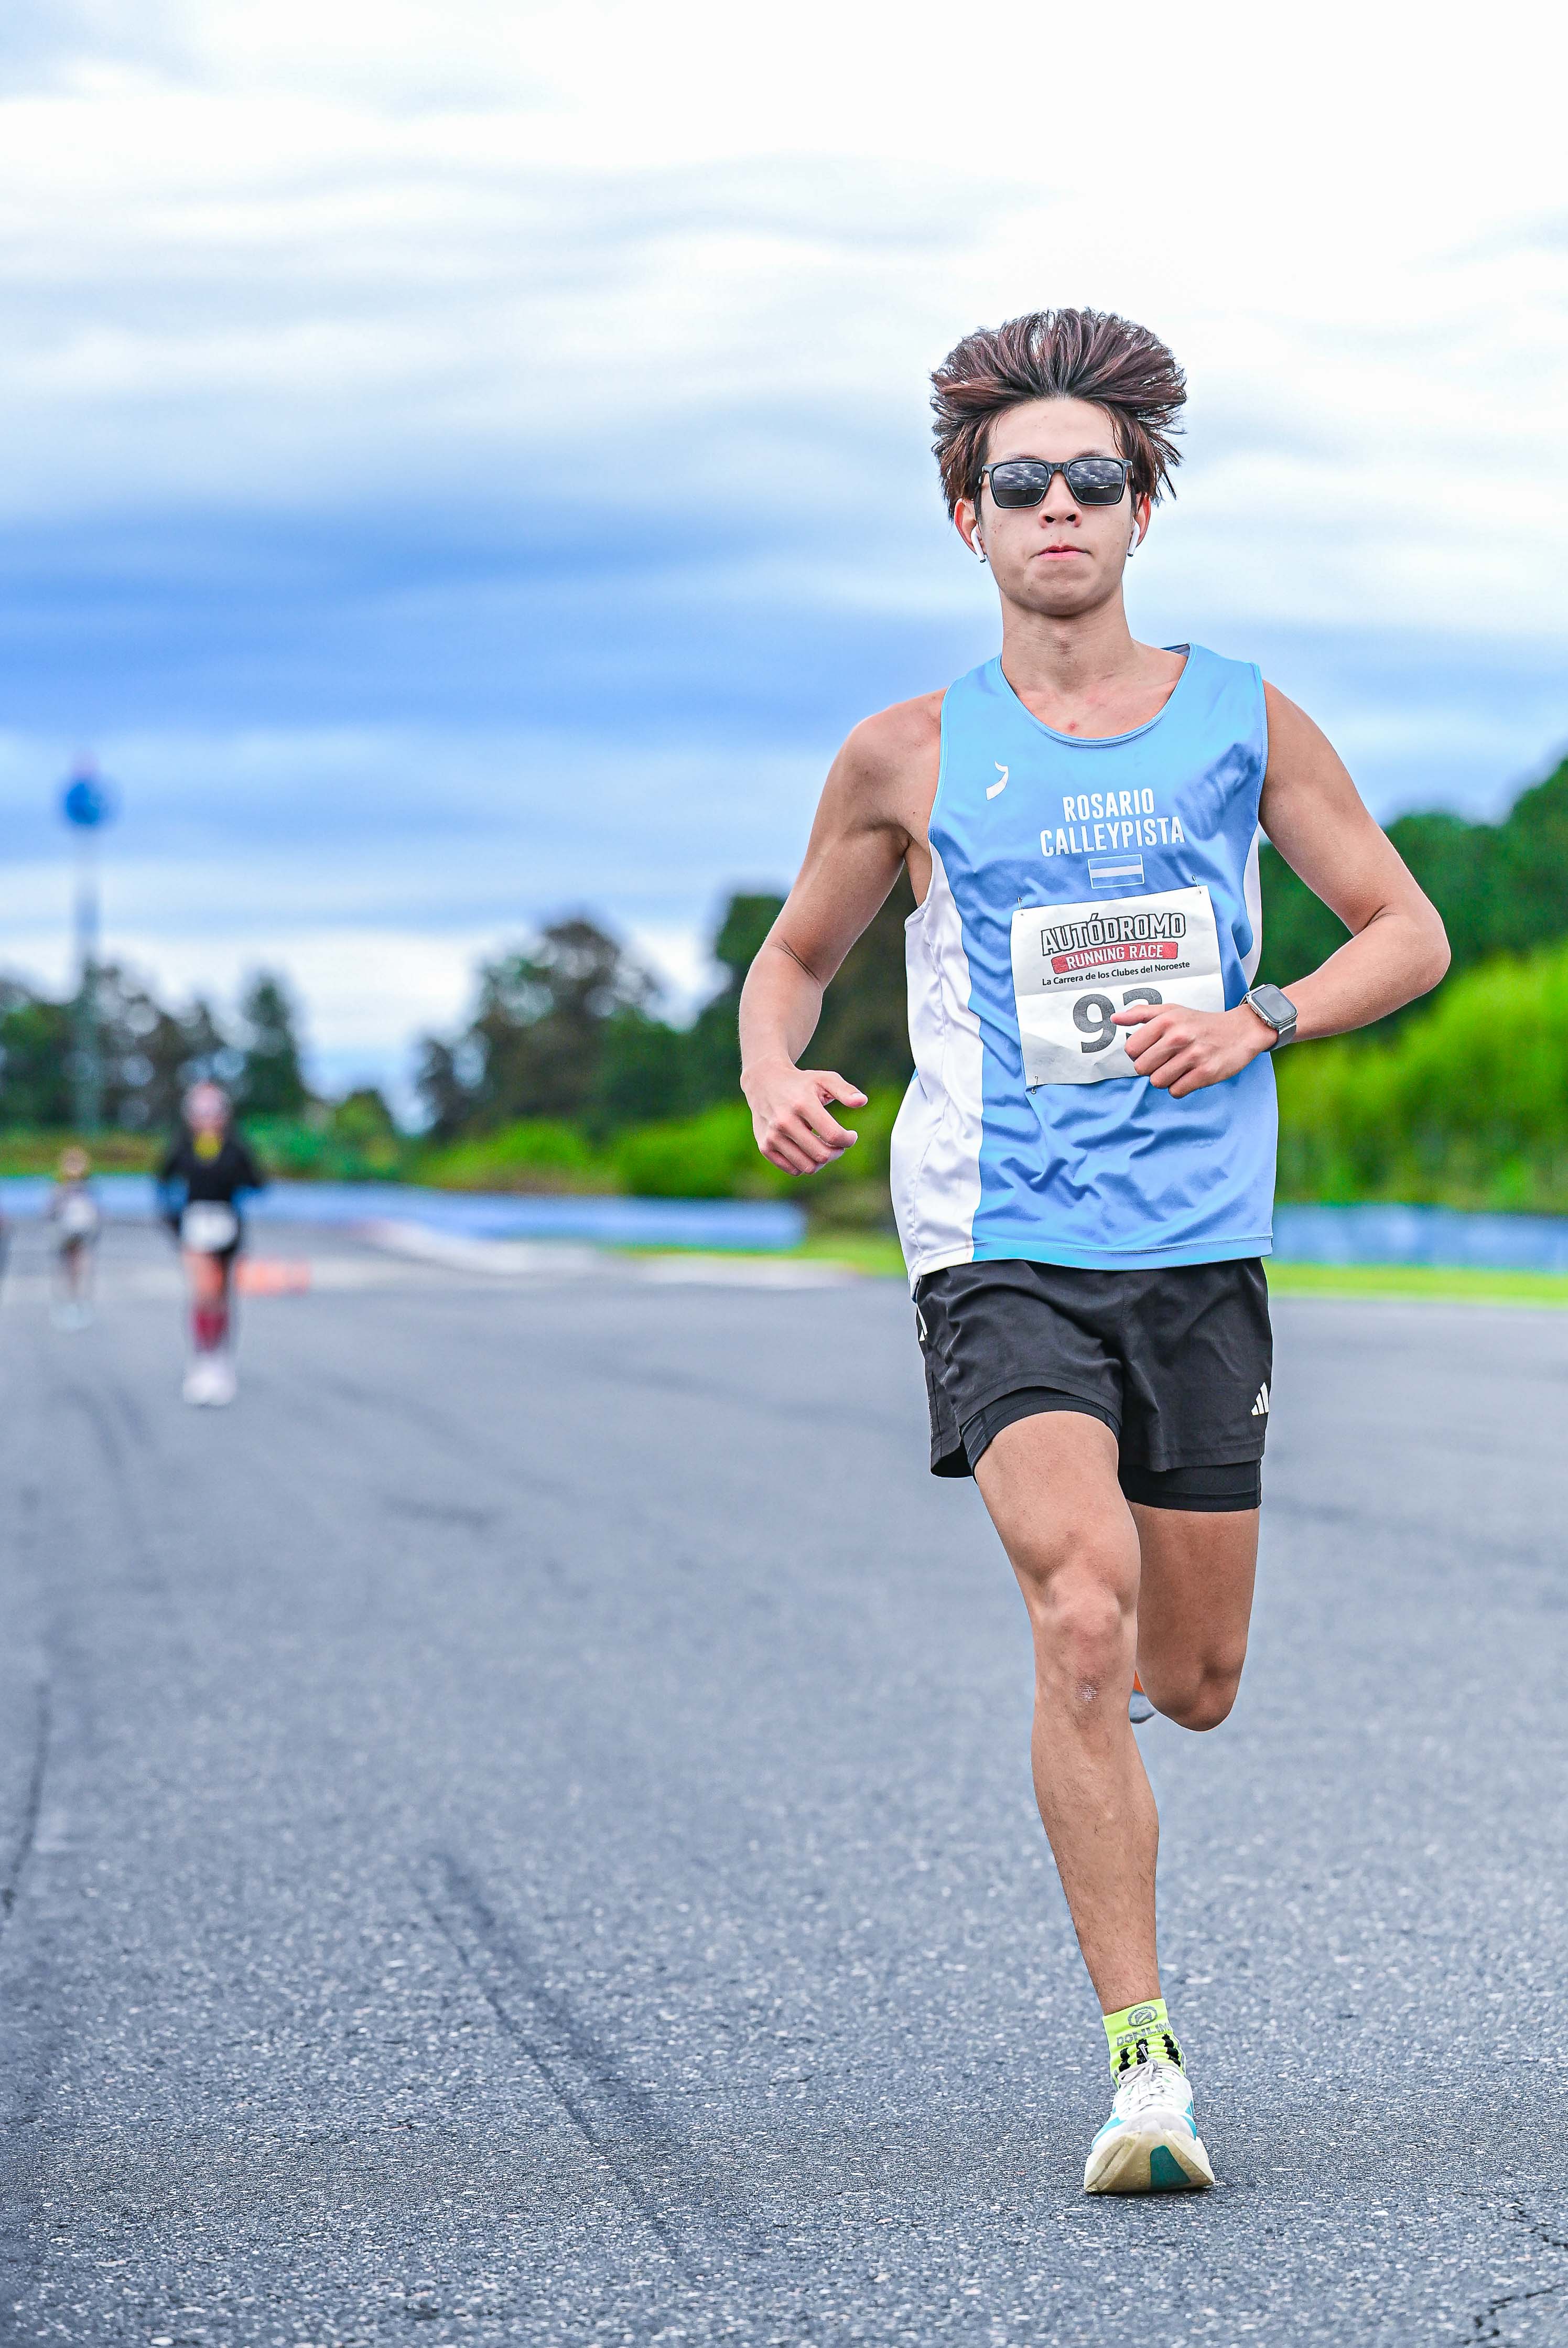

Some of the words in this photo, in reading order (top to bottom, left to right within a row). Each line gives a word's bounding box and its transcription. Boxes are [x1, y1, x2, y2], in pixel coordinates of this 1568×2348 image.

[1062, 788, 1154, 822] ROSARIO
[1040, 816, 1186, 857] CALLEYPISTA
[1041, 913, 1186, 956] AUTÓDROMO
[1053, 975, 1084, 985] Carrera
[1085, 972, 1096, 981] de
[1098, 970, 1110, 979] los
[1111, 967, 1139, 977] Clubes
[1140, 965, 1153, 974] del
[1155, 962, 1190, 972] Noroeste
[1065, 946, 1125, 970] RUNNING
[1129, 944, 1164, 958] RACE
